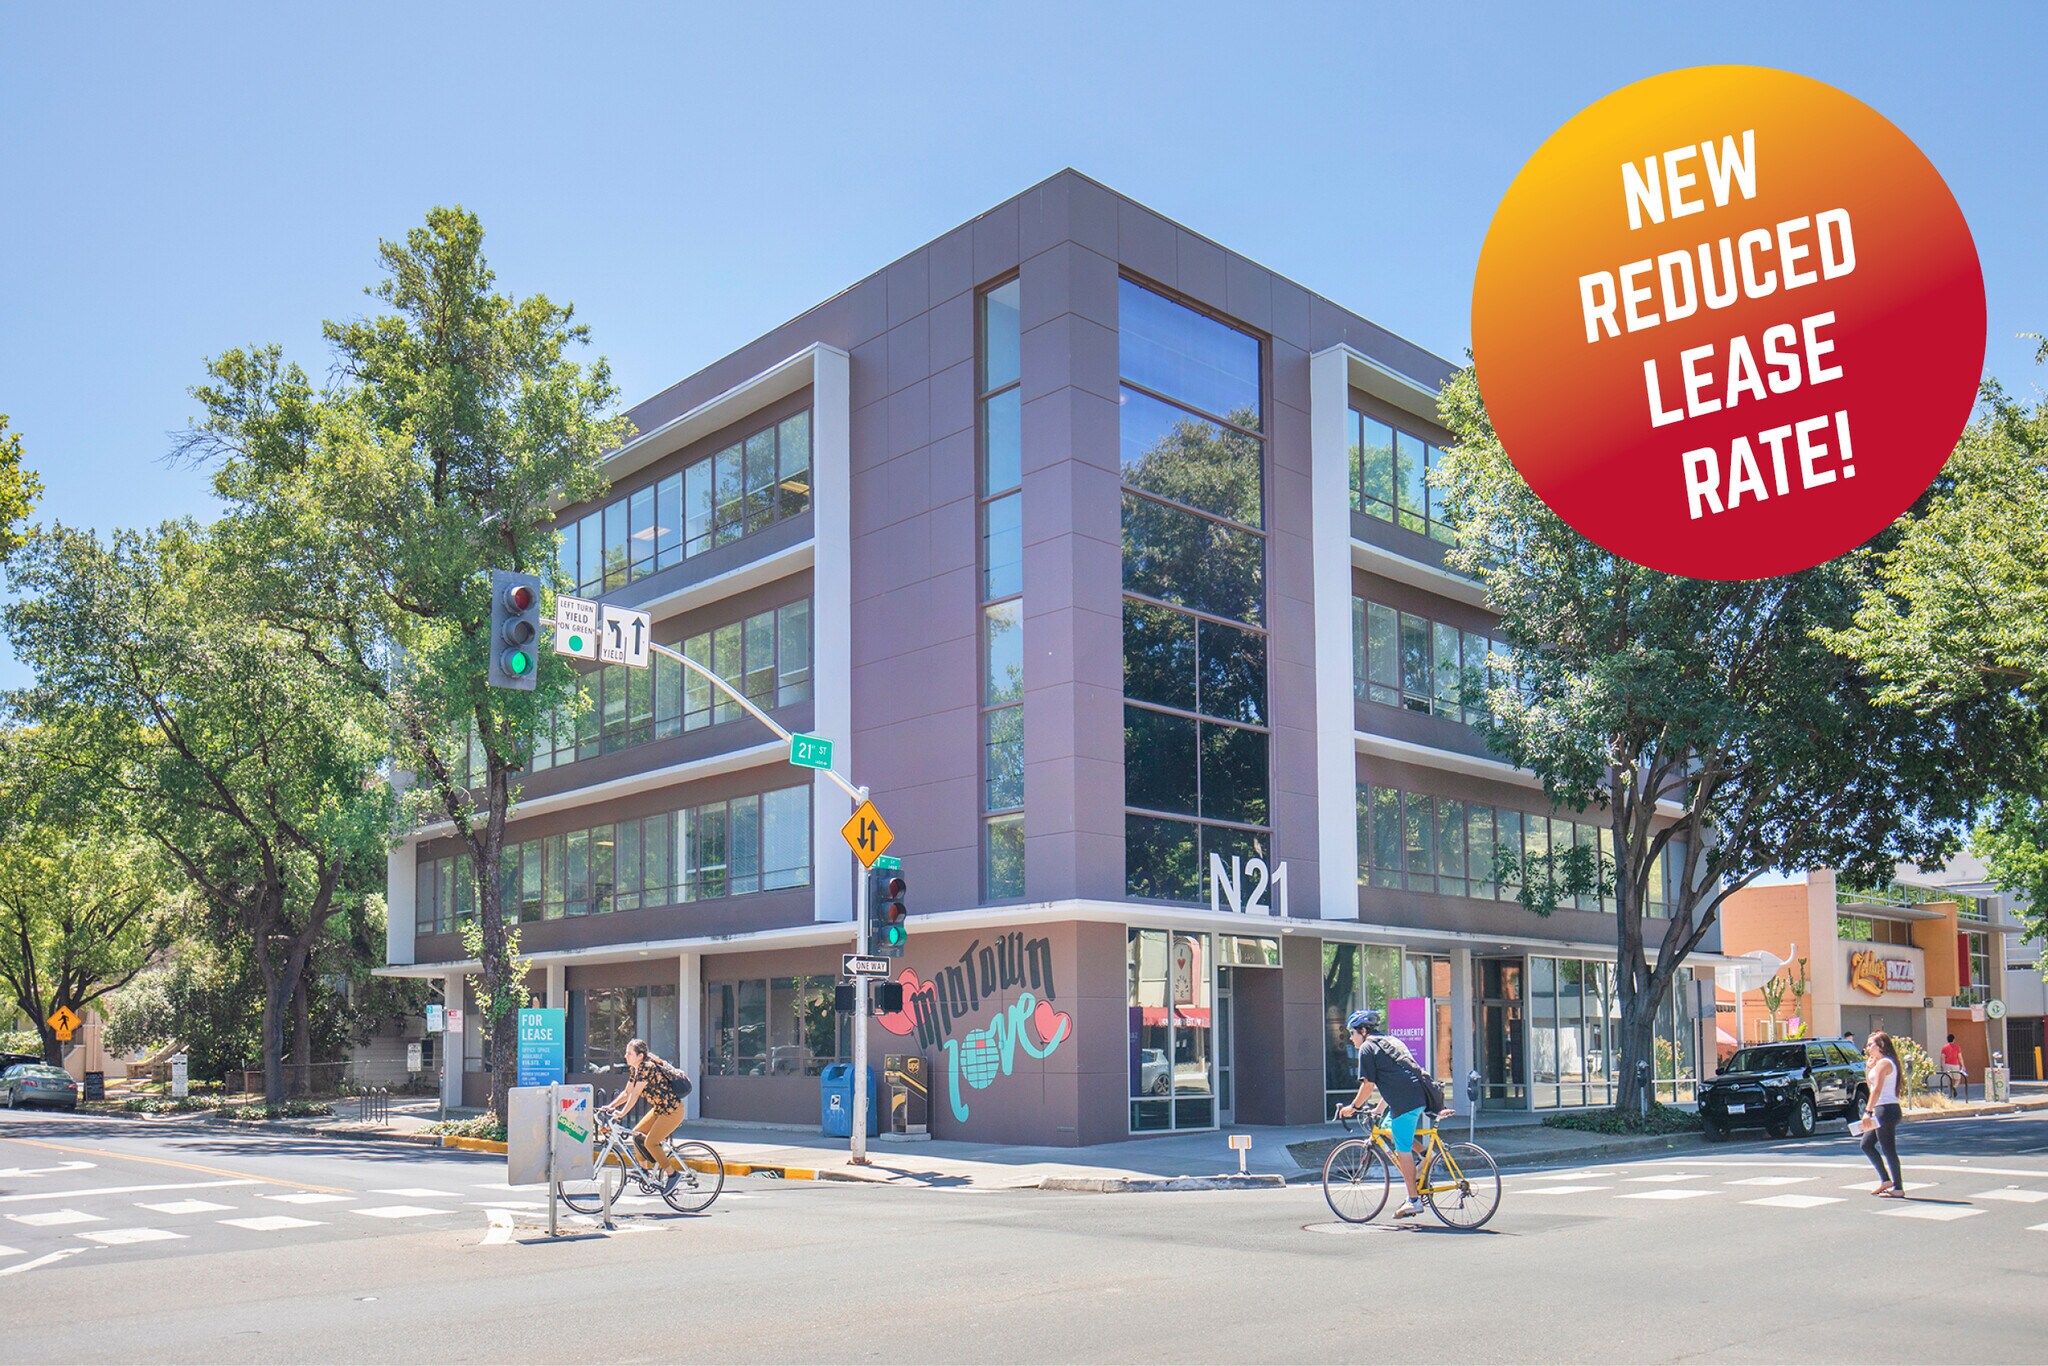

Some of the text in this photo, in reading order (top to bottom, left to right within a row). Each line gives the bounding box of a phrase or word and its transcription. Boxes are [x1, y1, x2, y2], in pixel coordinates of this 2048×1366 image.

[560, 600, 594, 613] LEFT TURN
[565, 611, 589, 624] YIELD
[603, 648, 624, 660] YIELD
[819, 746, 827, 755] ST
[1209, 852, 1289, 917] N21
[856, 961, 886, 971] ONE WAY
[522, 1014, 543, 1027] FOR
[522, 1029, 553, 1041] LEASE
[1391, 1028, 1425, 1037] SACRAMENTO
